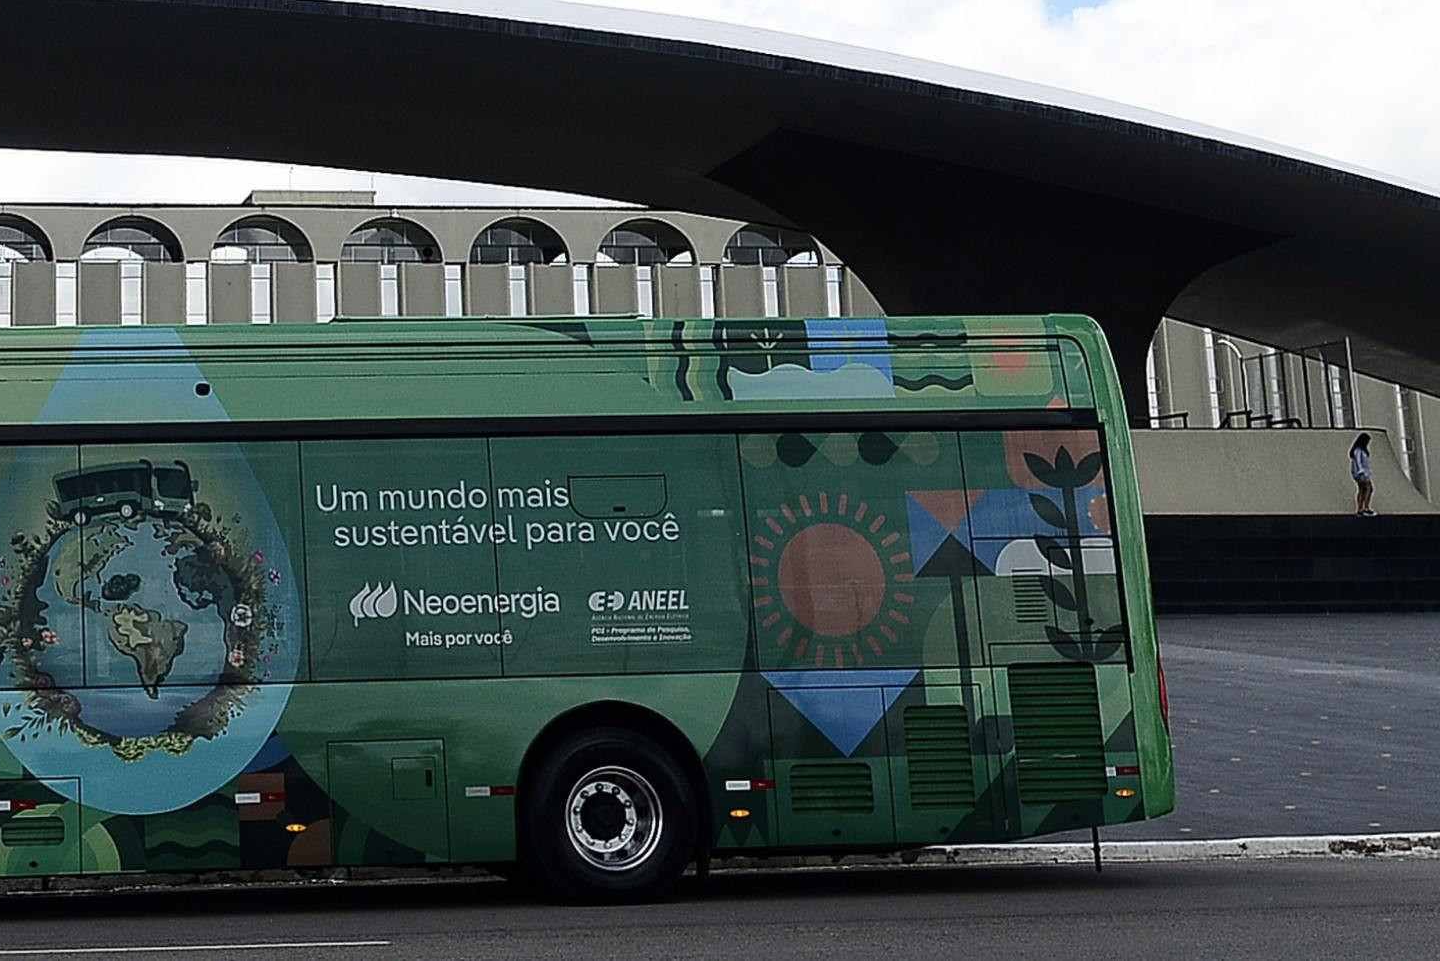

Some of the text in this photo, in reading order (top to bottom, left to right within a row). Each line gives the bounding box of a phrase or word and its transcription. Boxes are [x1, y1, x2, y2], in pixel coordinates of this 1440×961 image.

[316, 479, 570, 512] Um mundo mais
[334, 512, 680, 550] sustentável para você
[403, 586, 561, 618] Neoenergia
[628, 590, 689, 610] ANEEL
[406, 630, 513, 649] Mais por você
